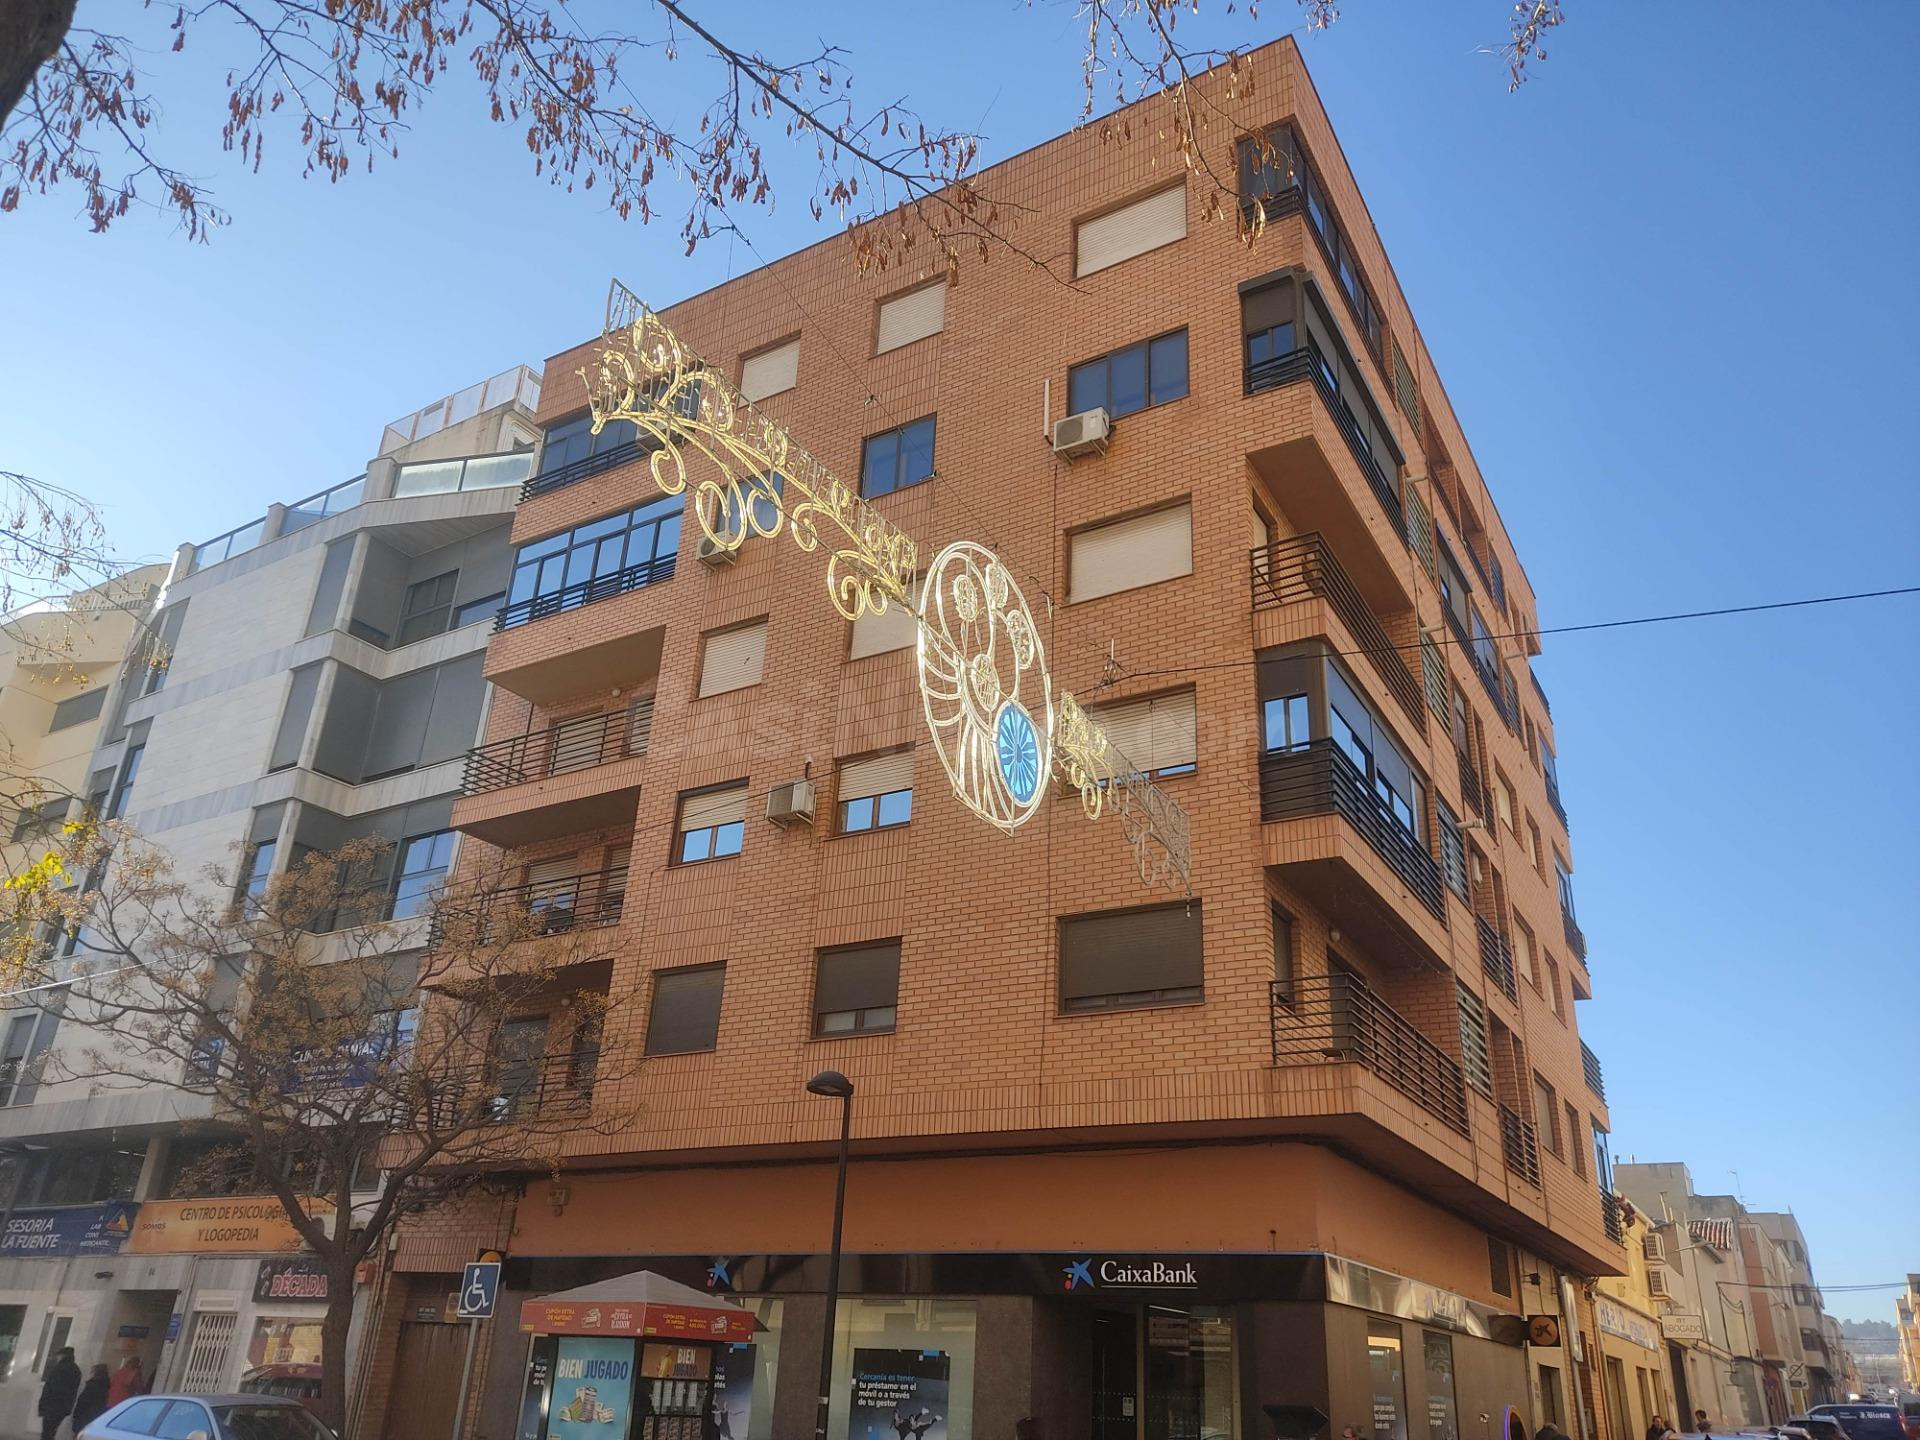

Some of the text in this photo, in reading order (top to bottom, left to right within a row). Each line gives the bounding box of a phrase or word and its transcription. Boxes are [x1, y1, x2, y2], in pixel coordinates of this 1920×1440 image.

[180, 1206, 217, 1221] CENTRO
[217, 1206, 232, 1220] DE
[198, 1227, 259, 1242] Y LOGOPEDIA
[1100, 1260, 1198, 1284] CaixaBank
[677, 1348, 696, 1364] BIEN
[558, 1359, 583, 1378] BIEN
[584, 1360, 628, 1379] JUGADO
[867, 1382, 898, 1391] préstamo
[858, 1390, 877, 1398] móvil
[889, 1391, 910, 1399] través
[858, 1398, 866, 1406] de
[876, 1400, 897, 1408] gestor
